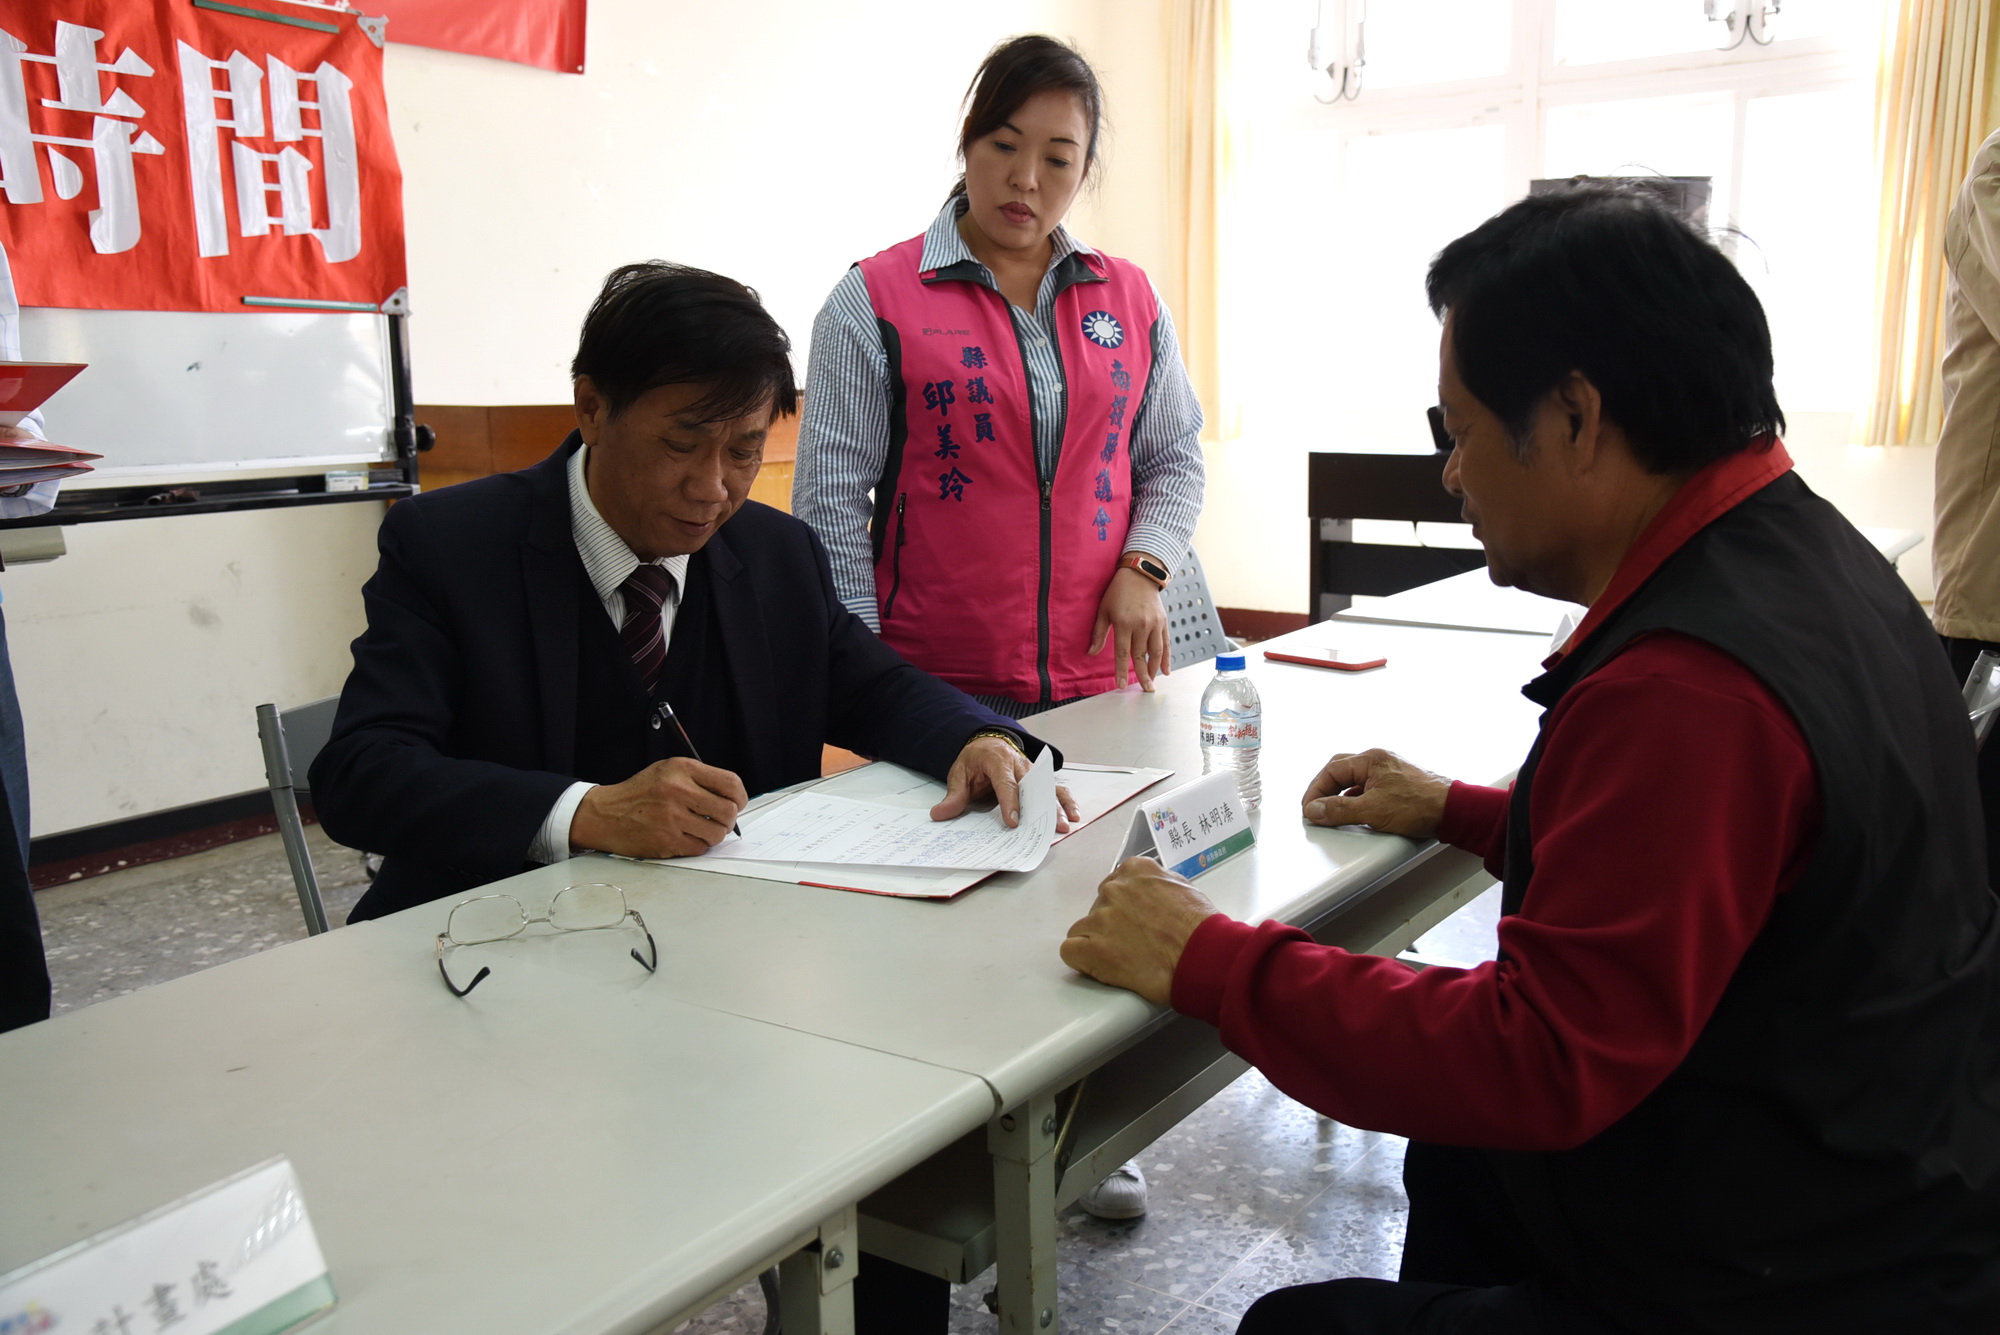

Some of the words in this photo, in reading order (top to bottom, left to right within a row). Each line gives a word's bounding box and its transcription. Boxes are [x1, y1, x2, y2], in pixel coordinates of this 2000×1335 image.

[0, 20, 361, 263] 時間
[921, 380, 973, 501] 邱美玲
[960, 347, 996, 442] 縣議員
[1092, 359, 1131, 541] 南投縣議會
[1168, 821, 1196, 850] 縣長
[1198, 802, 1234, 835] 林明溱
